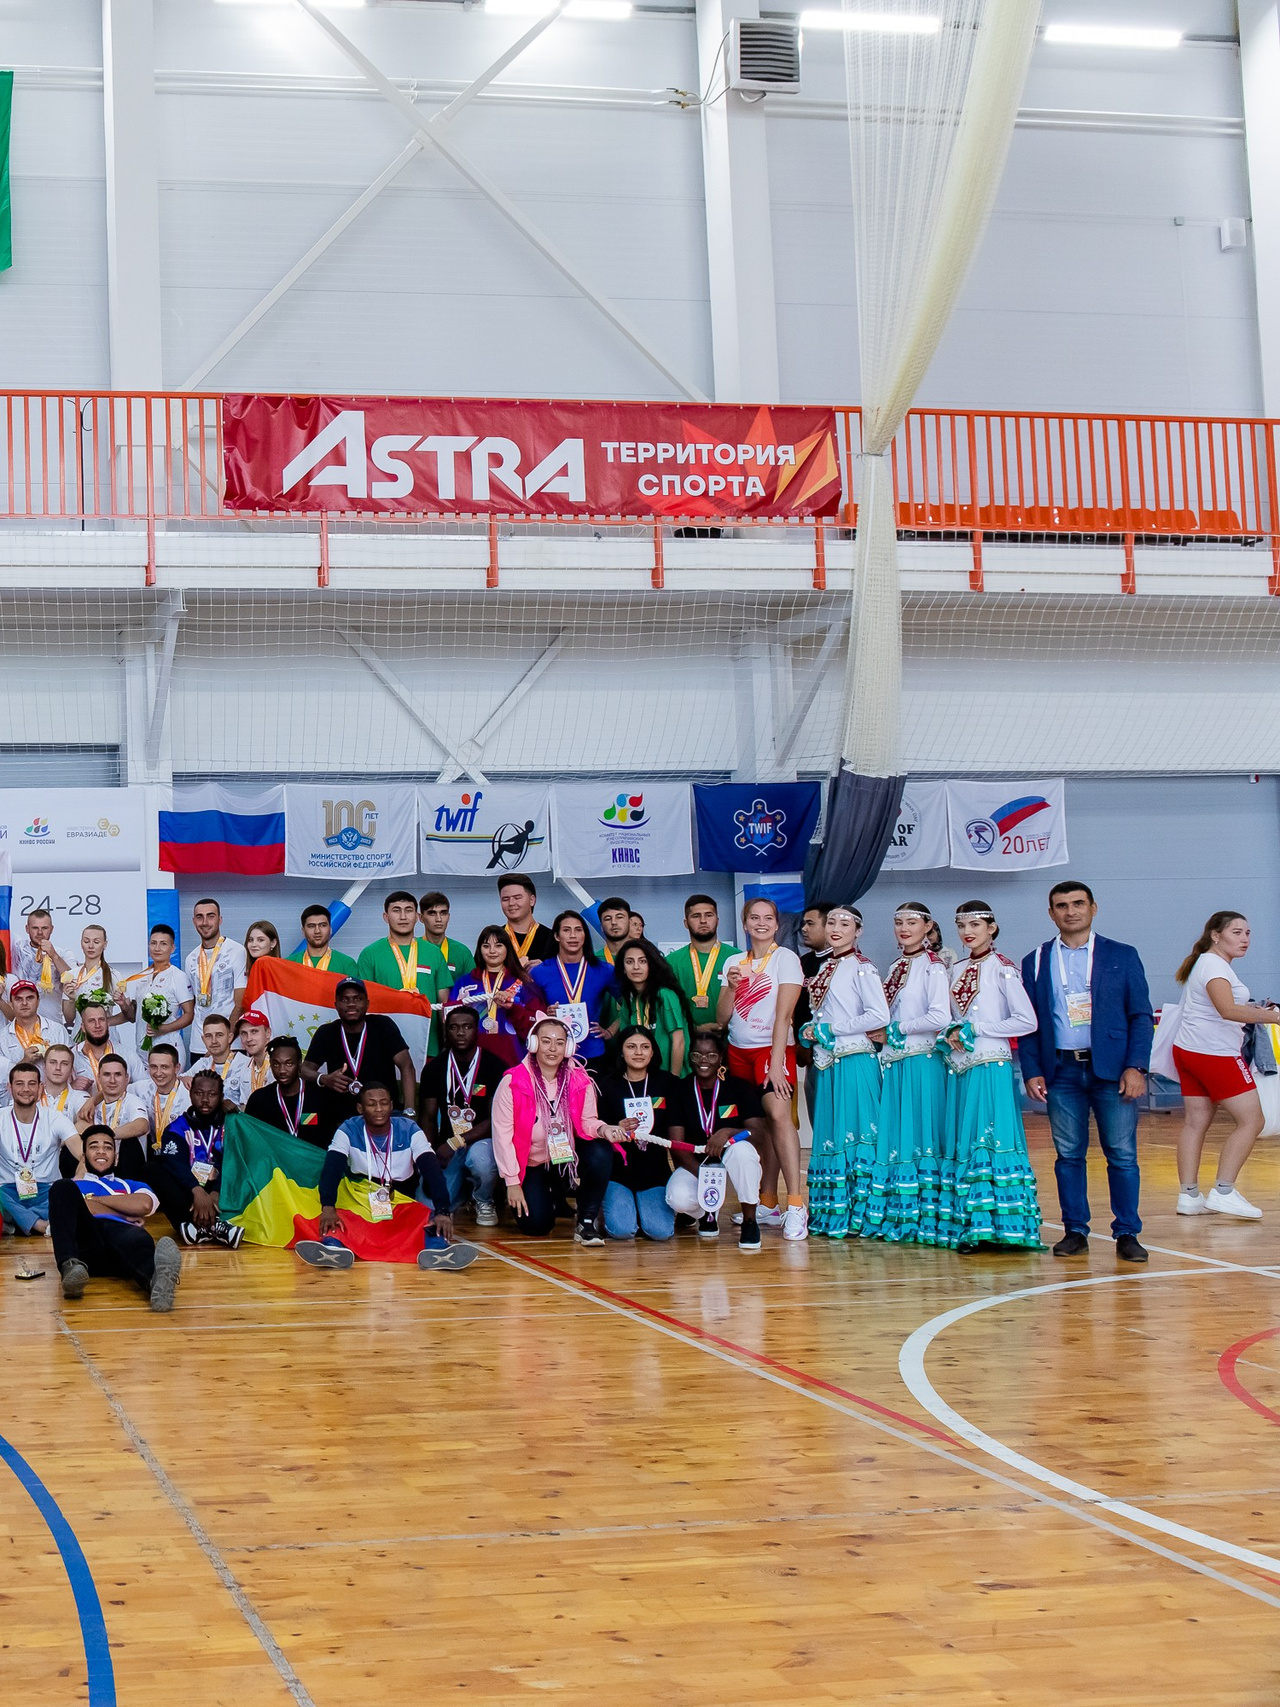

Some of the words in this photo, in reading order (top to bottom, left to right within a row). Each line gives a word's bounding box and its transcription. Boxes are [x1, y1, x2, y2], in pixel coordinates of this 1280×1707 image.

[282, 410, 587, 502] ASTRA
[601, 441, 797, 466] ТЕРРИТОРИЯ
[637, 474, 767, 498] СПОРТА
[434, 791, 483, 832] twif
[748, 822, 772, 835] TWIF
[897, 823, 916, 835] OF
[889, 835, 909, 847] AR
[308, 860, 352, 869] РОССИЙСКОЙ
[352, 860, 394, 869] ФЕДЕРАЦИИ
[310, 853, 365, 861] МИНИСТЕРСТВО
[366, 853, 392, 861] СПОРТА
[20, 894, 102, 917] 24-28
